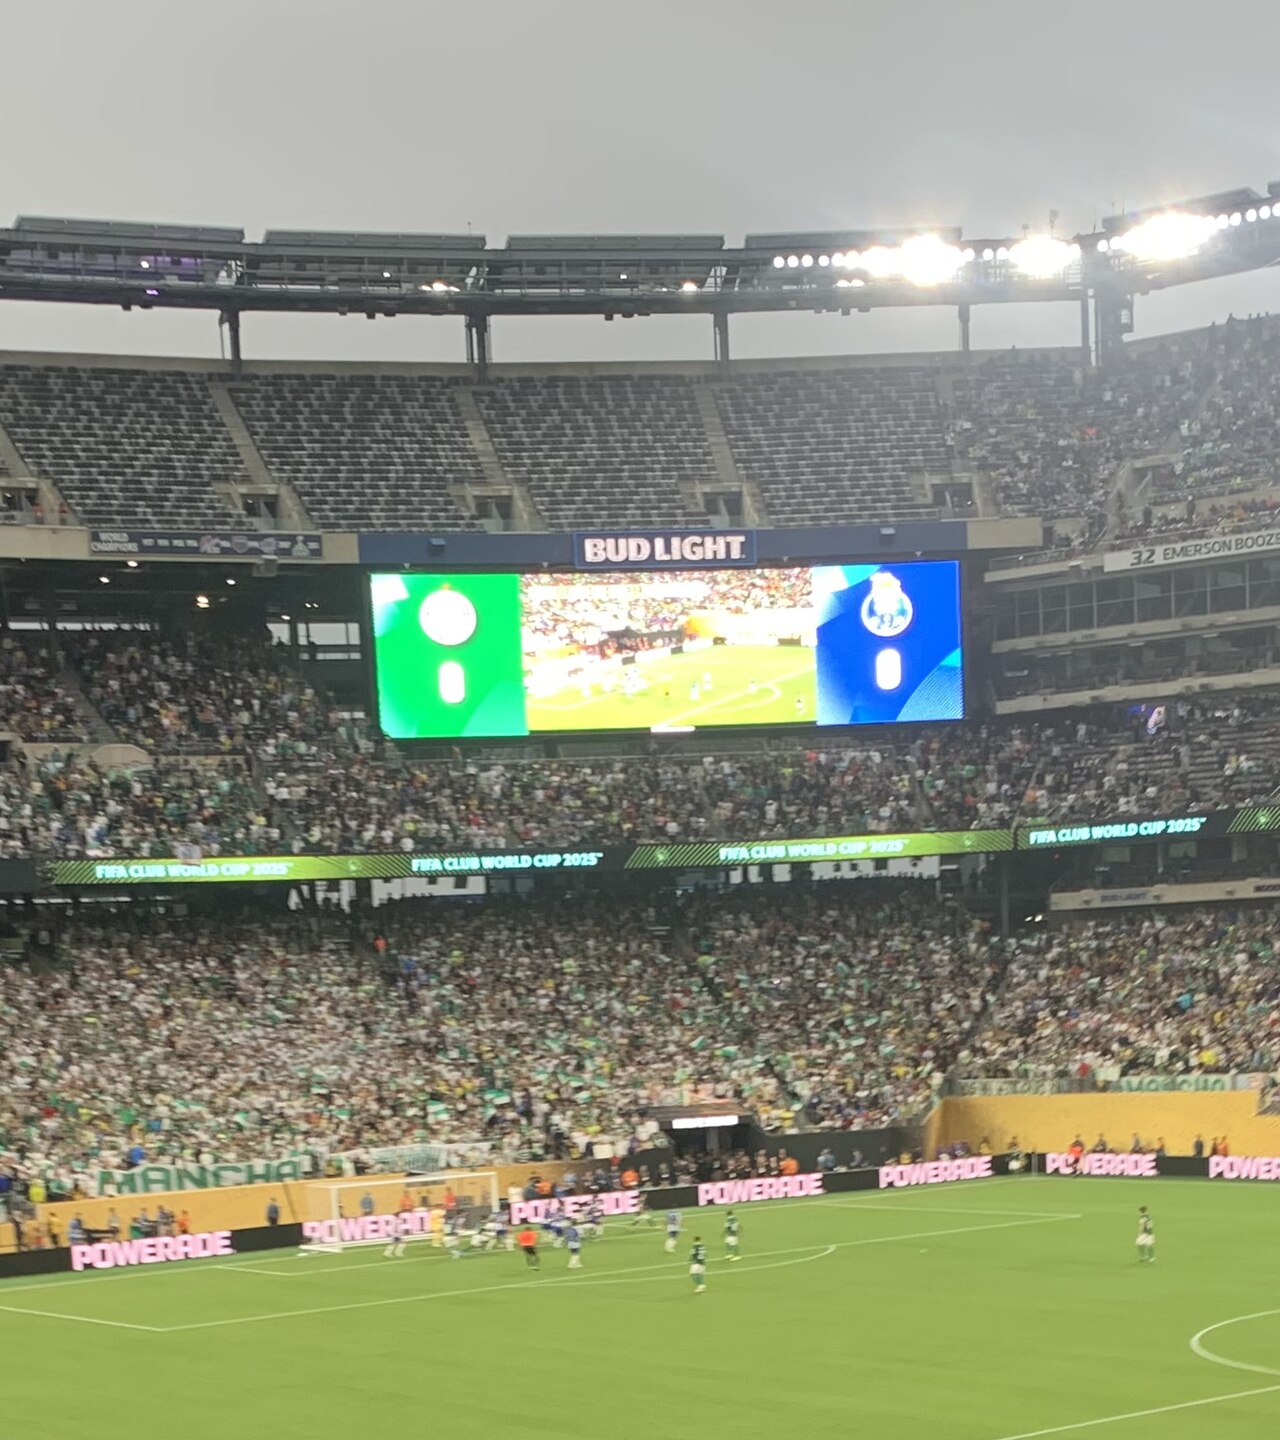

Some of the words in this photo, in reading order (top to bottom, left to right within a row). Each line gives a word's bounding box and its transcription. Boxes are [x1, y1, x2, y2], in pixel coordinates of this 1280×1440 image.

[584, 538, 653, 563] BUD
[654, 535, 746, 562] LIGHT
[1130, 549, 1155, 567] 32
[1163, 539, 1235, 561] EMERSON
[1030, 830, 1057, 844] FIFA
[1058, 828, 1090, 842] CLUB
[1091, 823, 1138, 839] WORLD
[1139, 820, 1166, 835] CUP
[412, 858, 443, 871] FIFA
[443, 857, 481, 871] CLUB
[481, 854, 532, 869] WORLD
[533, 854, 562, 868] CUP
[720, 847, 749, 860] FIFA
[750, 845, 786, 858] CLUB
[787, 843, 837, 857] WORLD
[838, 842, 867, 855] CUP
[95, 864, 128, 878] FIFA
[129, 864, 166, 878] CLUB
[166, 863, 220, 877] WORLD
[221, 863, 251, 876] CUP
[98, 1161, 300, 1196] MANCHA
[879, 1156, 993, 1189] POWERADE
[698, 1173, 824, 1206] POWERADE
[72, 1231, 233, 1271] POWERADE
